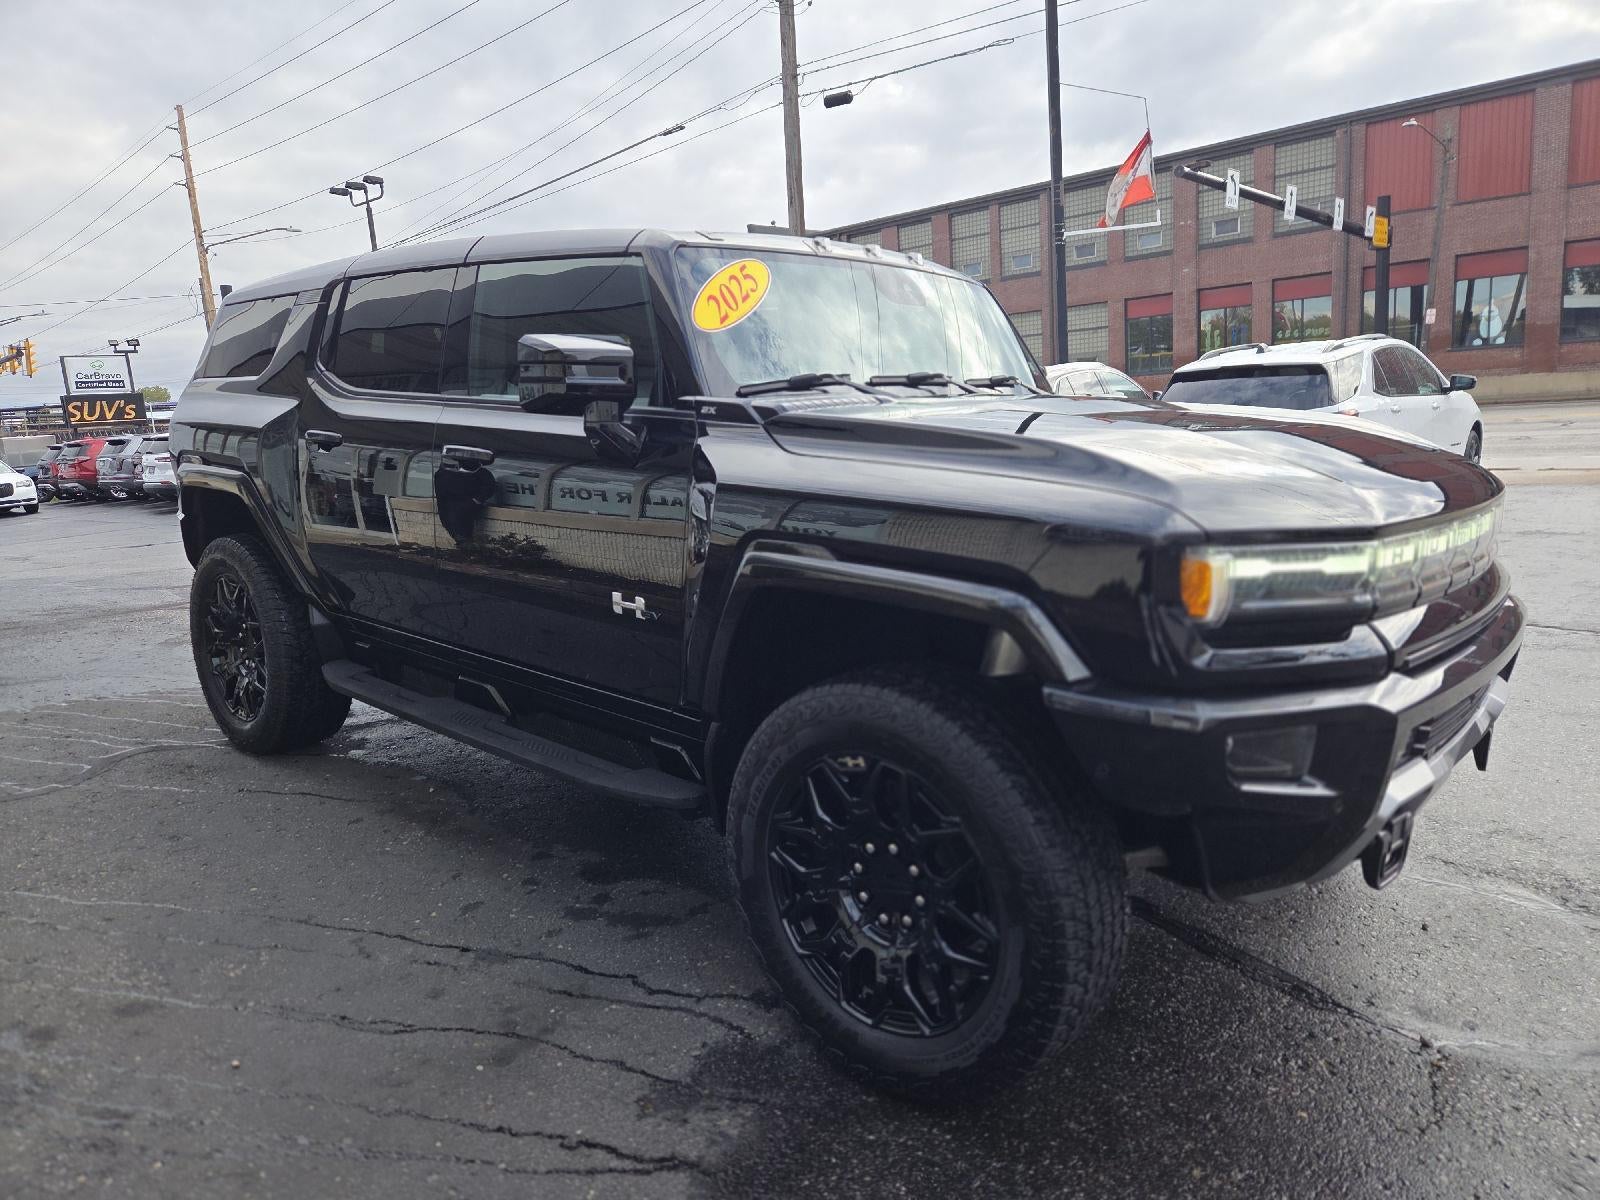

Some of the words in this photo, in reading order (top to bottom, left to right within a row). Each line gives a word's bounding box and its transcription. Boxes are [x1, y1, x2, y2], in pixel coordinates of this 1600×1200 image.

[707, 264, 758, 325] 2025
[76, 371, 122, 380] CarBravo
[68, 400, 136, 421] SUV's
